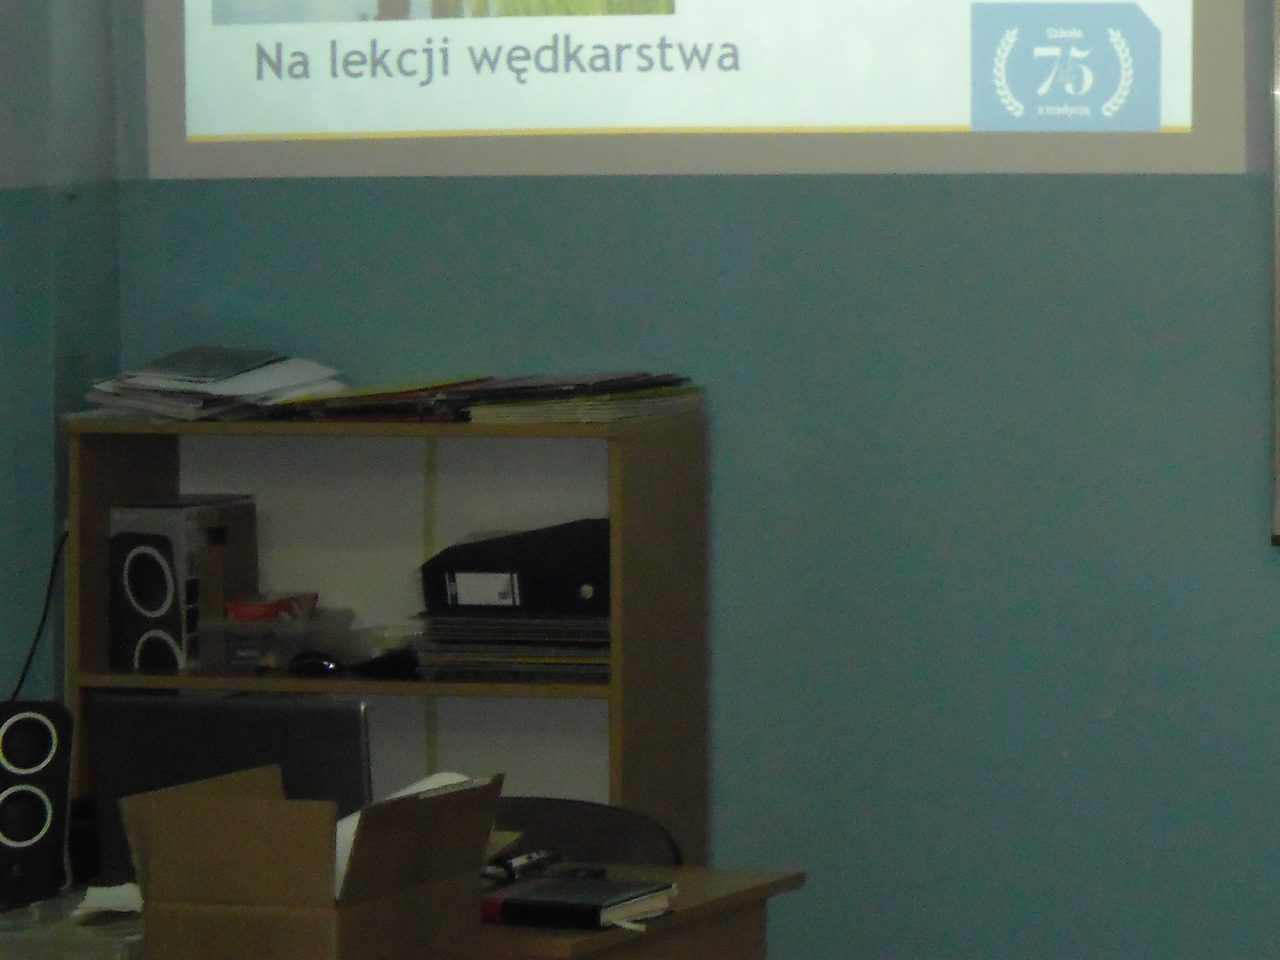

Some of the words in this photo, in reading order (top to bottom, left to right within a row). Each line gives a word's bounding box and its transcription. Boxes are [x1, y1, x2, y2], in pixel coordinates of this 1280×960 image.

[255, 41, 311, 81] Na
[330, 37, 451, 87] lekcji
[467, 33, 741, 84] wędkarstwa
[1033, 46, 1093, 96] 75
